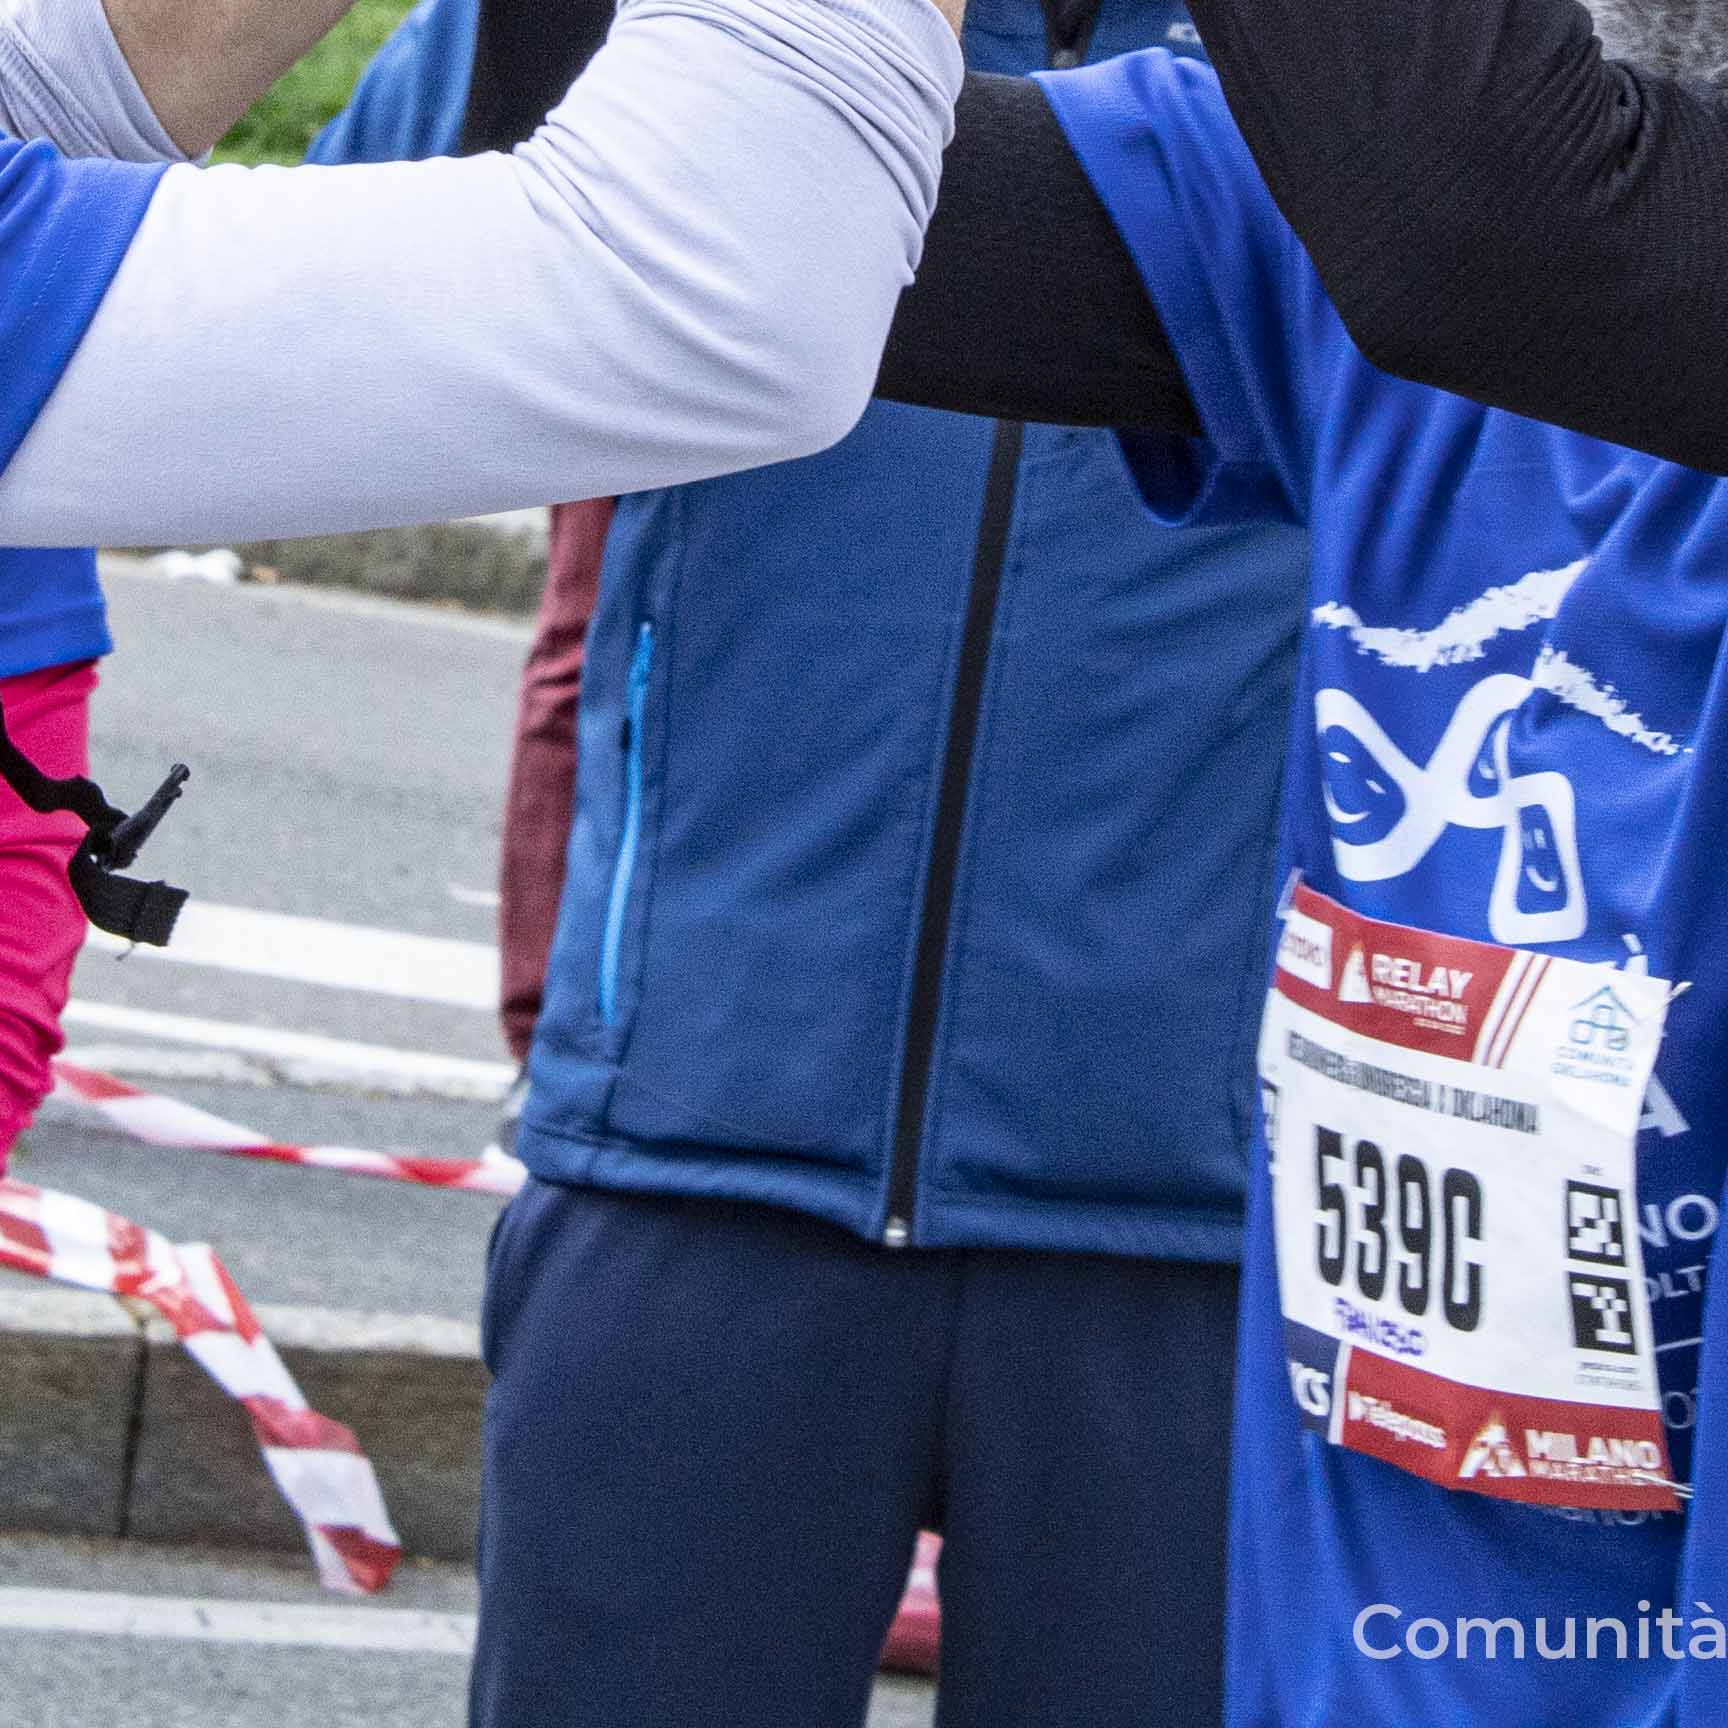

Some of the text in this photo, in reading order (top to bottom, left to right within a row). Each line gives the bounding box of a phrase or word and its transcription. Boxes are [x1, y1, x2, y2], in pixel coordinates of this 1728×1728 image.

[1372, 953, 1474, 1000] RELAY
[1314, 1124, 1483, 1333] 539C
[1525, 1428, 1662, 1469] MILANO
